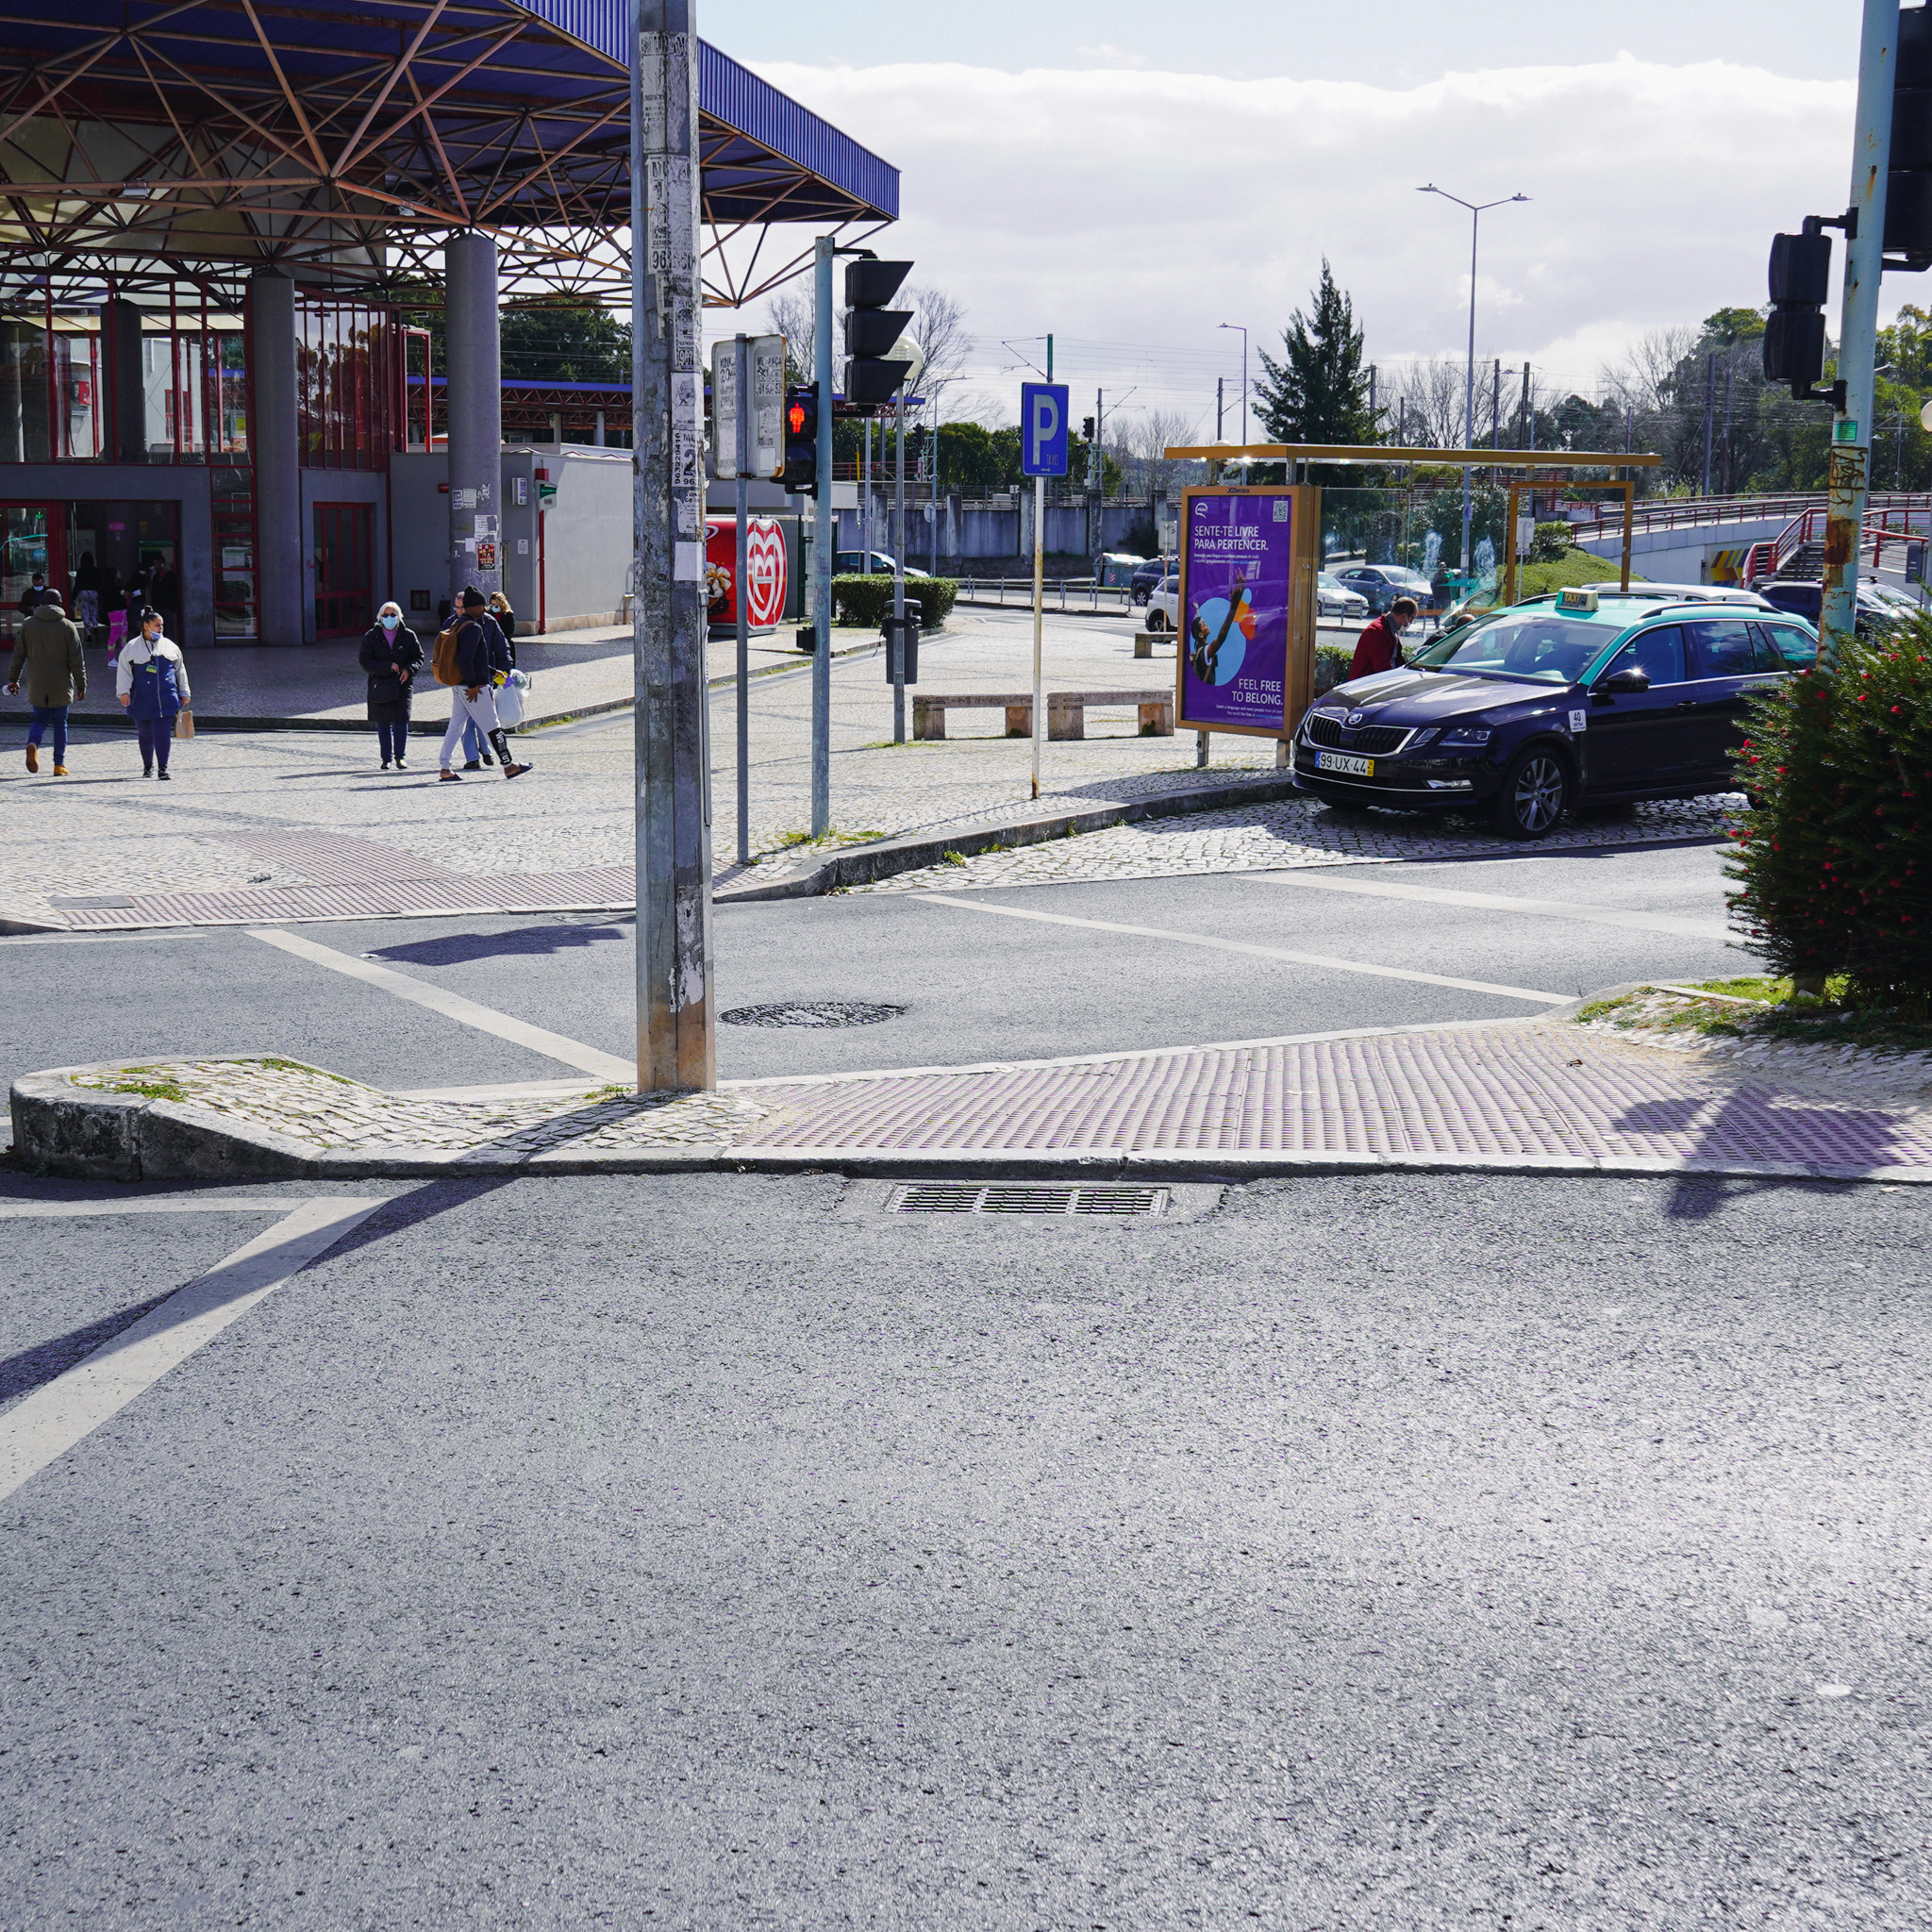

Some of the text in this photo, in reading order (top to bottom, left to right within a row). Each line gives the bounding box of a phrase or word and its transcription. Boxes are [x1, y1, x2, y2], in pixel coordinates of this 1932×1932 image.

[1033, 394, 1058, 465] P
[1194, 525, 1259, 537] SENTE-TE LIVRE
[1194, 539, 1269, 551] PARA PERTENCER.
[1564, 592, 1580, 603] TAXI
[1239, 678, 1282, 692] FEEL FREE
[1232, 691, 1283, 706] TO BELONG.
[1574, 711, 1581, 722] 40
